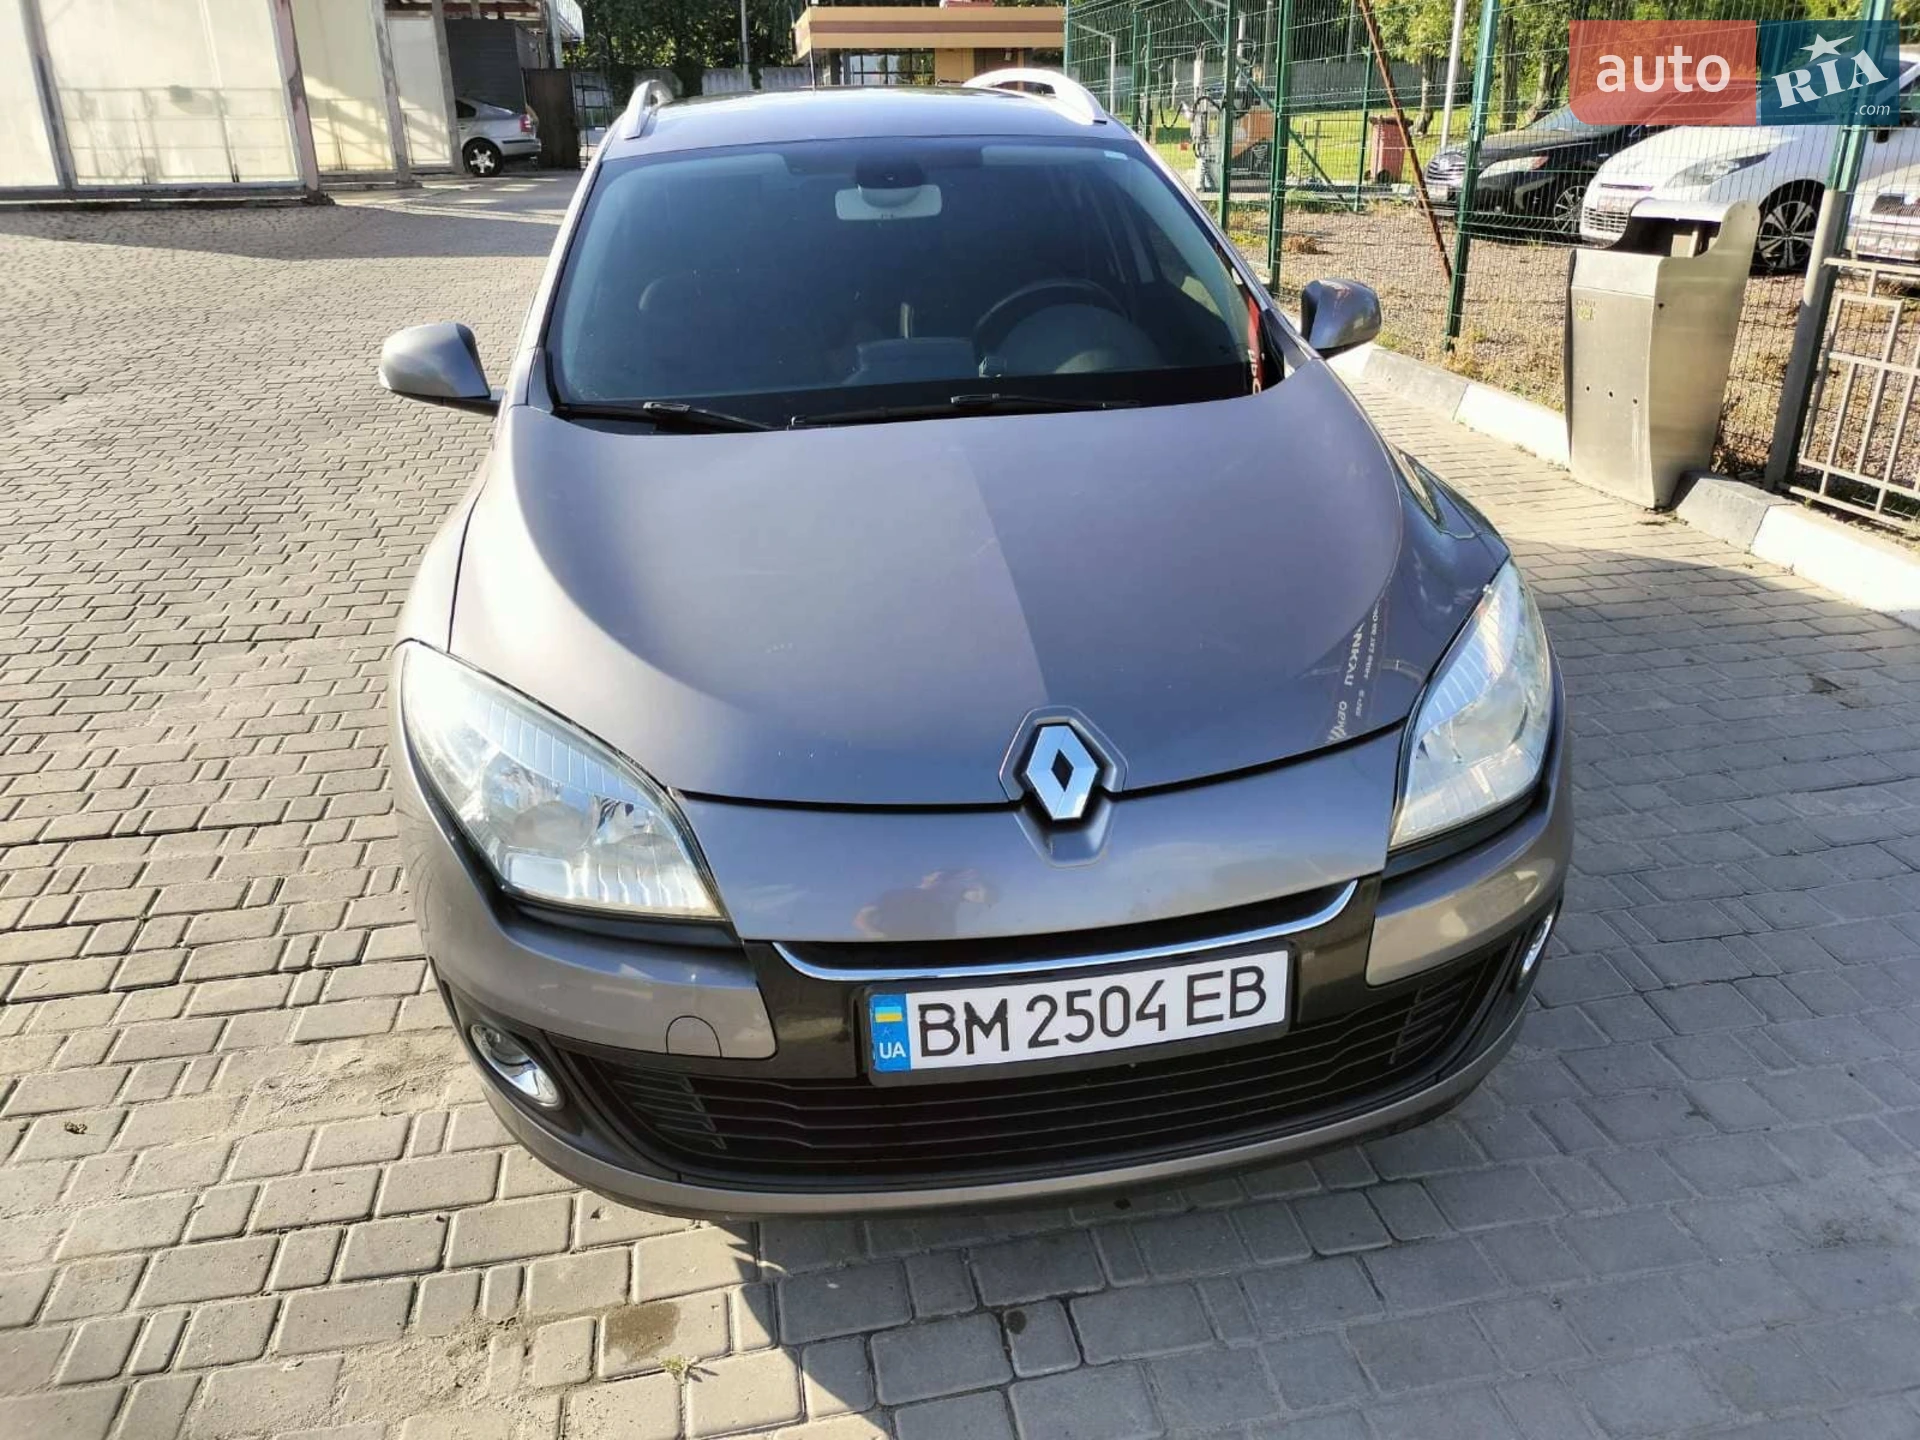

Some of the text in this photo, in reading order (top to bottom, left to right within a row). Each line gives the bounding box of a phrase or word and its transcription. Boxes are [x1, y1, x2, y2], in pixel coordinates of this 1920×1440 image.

[918, 965, 1267, 1057] BM 2504 EB
[879, 1041, 906, 1059] UA
